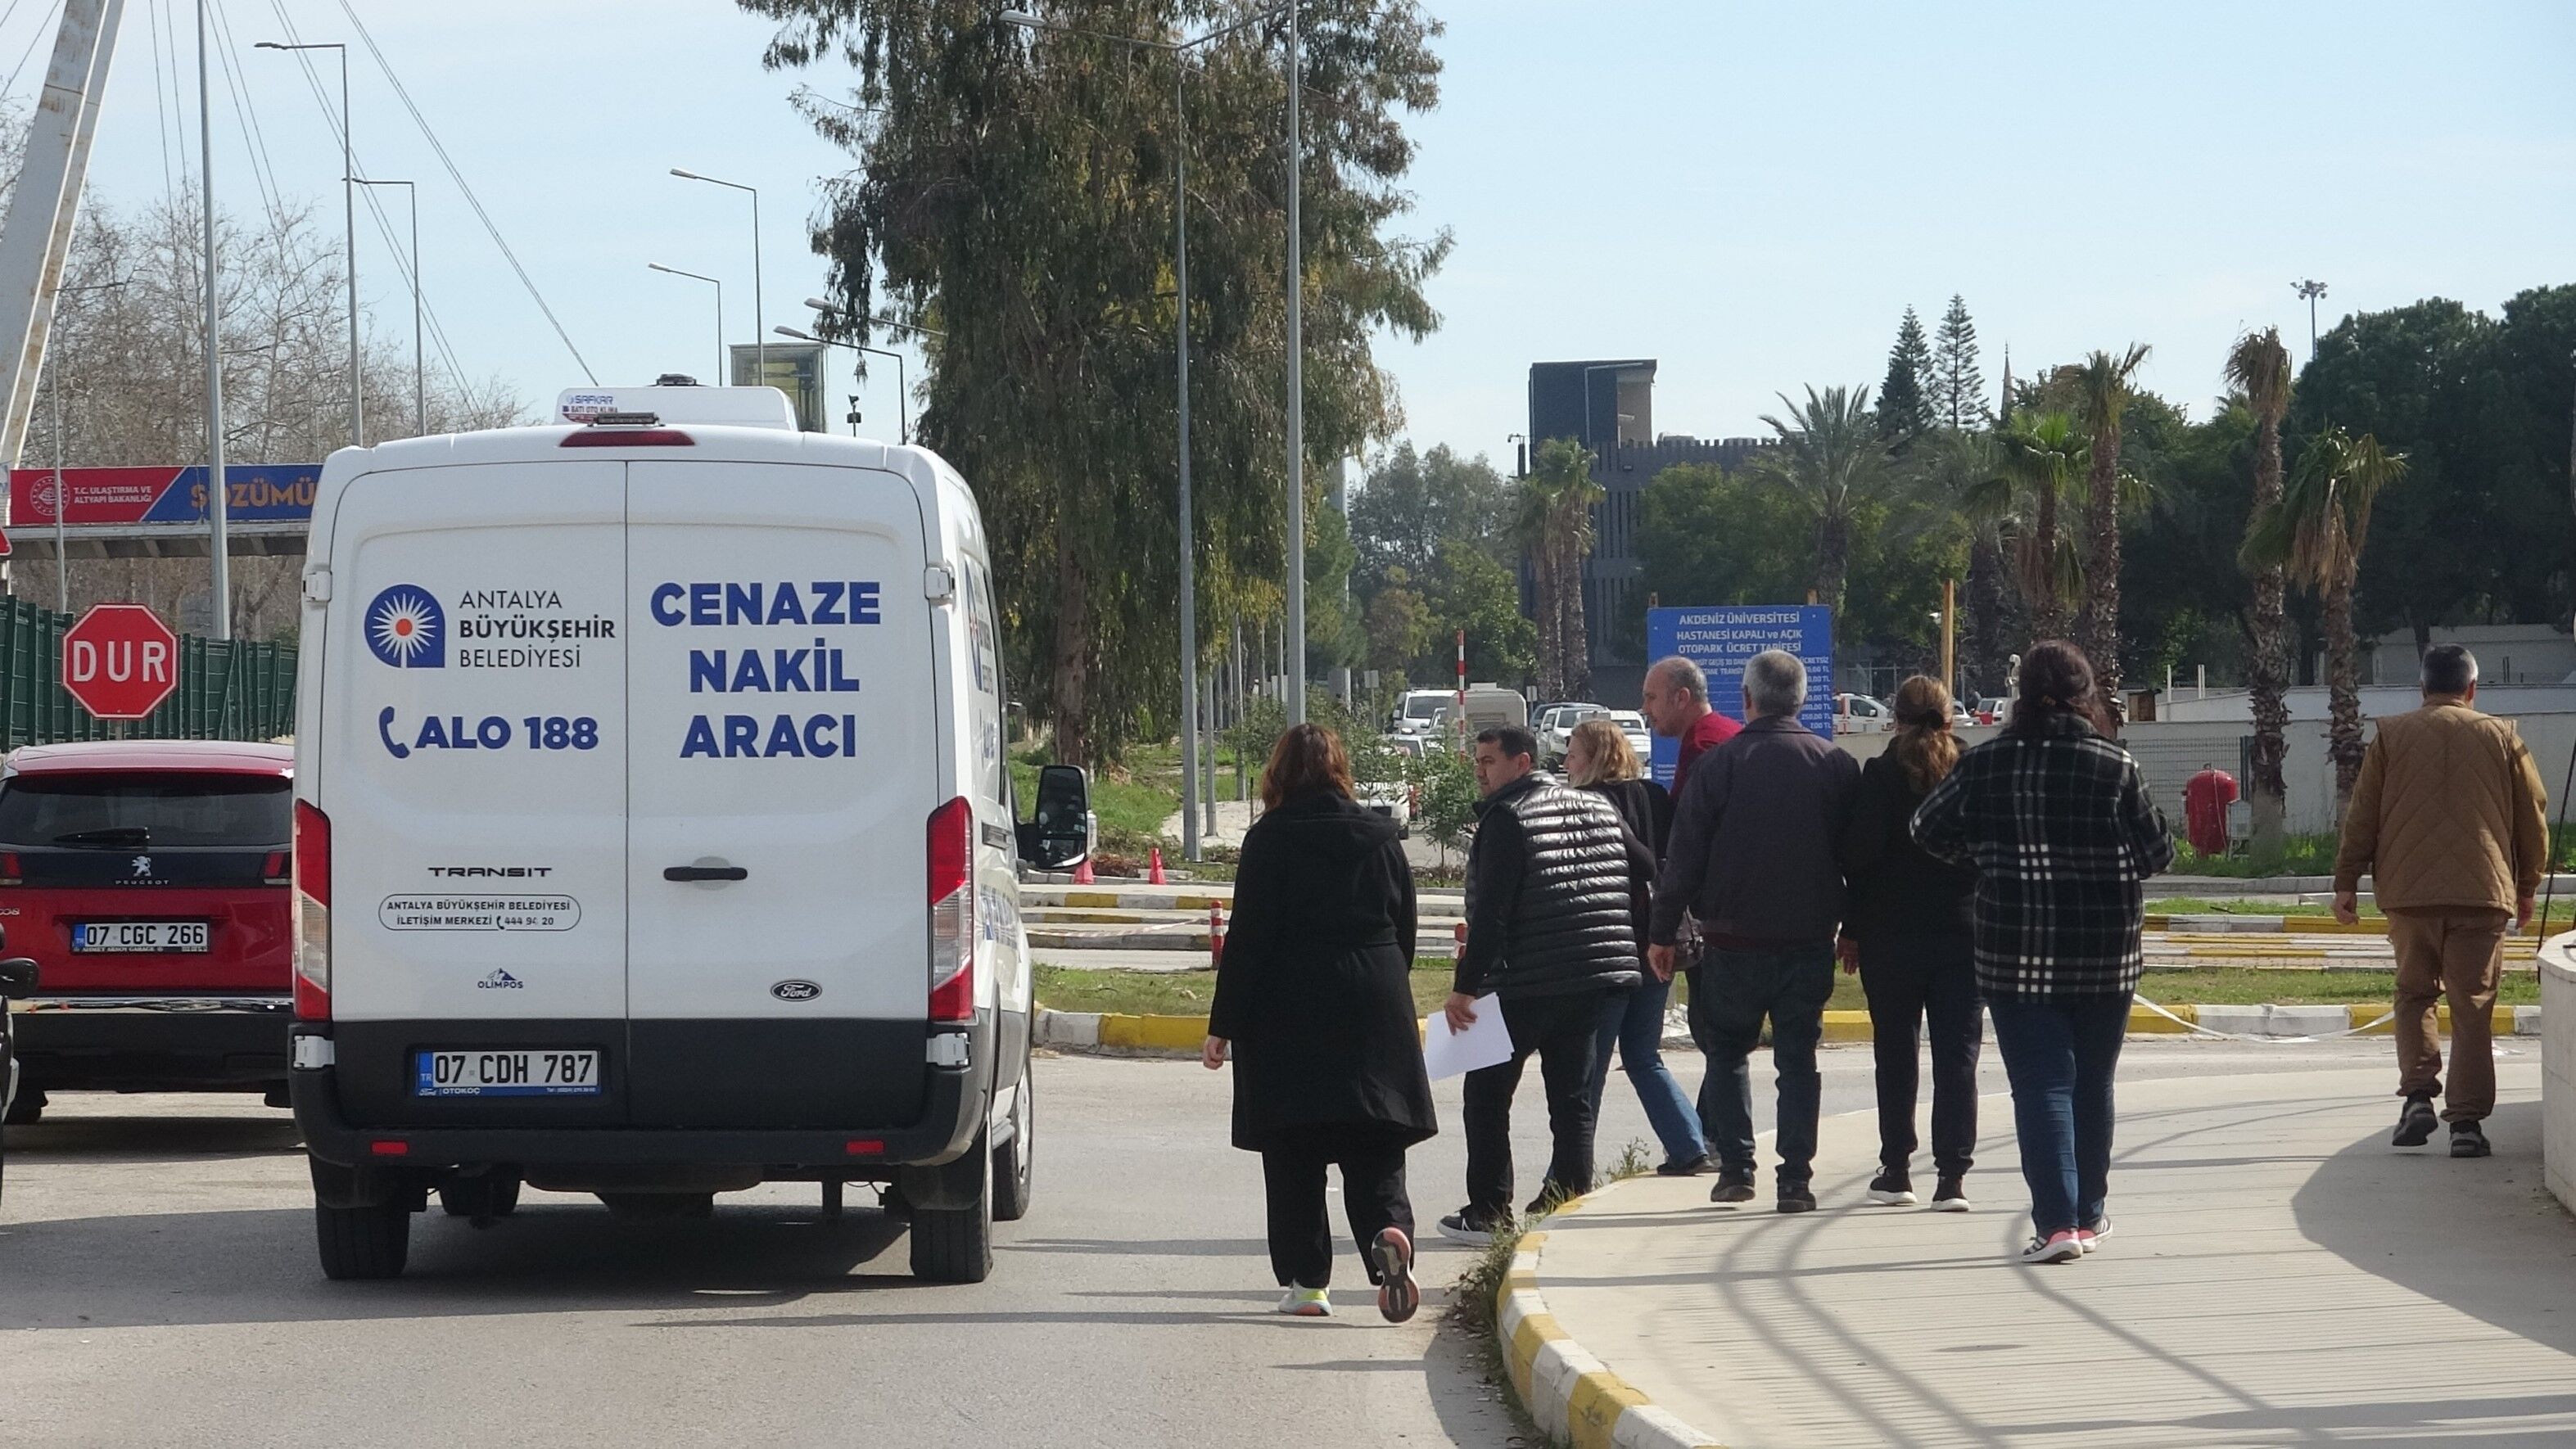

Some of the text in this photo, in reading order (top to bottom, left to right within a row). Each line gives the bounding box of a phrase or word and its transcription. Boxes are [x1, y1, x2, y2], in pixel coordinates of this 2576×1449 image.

[90, 485, 139, 495] ULAŞTIRMA
[140, 485, 152, 494] VE
[74, 494, 152, 503] ALTYAPI BAKANLIĞI
[459, 590, 563, 609] ANTALYA
[650, 581, 882, 627] CENAZE
[1679, 610, 1801, 625] AKDENİZ ÜNİVERSİTESİ
[459, 614, 616, 643] BÜYÜKŞEHİR
[1676, 628, 1803, 641] HASTANESİ KAPALI ve AÇIK
[1678, 640, 1801, 654] OTOPARK ÜCRET TARİFESİ
[73, 640, 167, 683] DUR
[459, 644, 581, 668] BELEDİYESİ
[689, 637, 860, 693] NAKİL
[414, 715, 599, 751] ALO 188
[679, 713, 856, 758] ARACI
[427, 867, 553, 878] TRANSIT
[386, 899, 571, 912] ANTALYA BÜYÜKŞEHİR BELEDİYESİ
[396, 914, 442, 927] İLETİŞİM
[445, 914, 492, 926] MERKEZİ
[541, 917, 554, 926] 20
[87, 925, 204, 946] 07 CGC 266
[780, 984, 812, 997] Ford
[435, 1054, 593, 1084] 07 CDH 787
[420, 1073, 432, 1081] TR
[442, 1087, 481, 1095] OTOKOÇ
